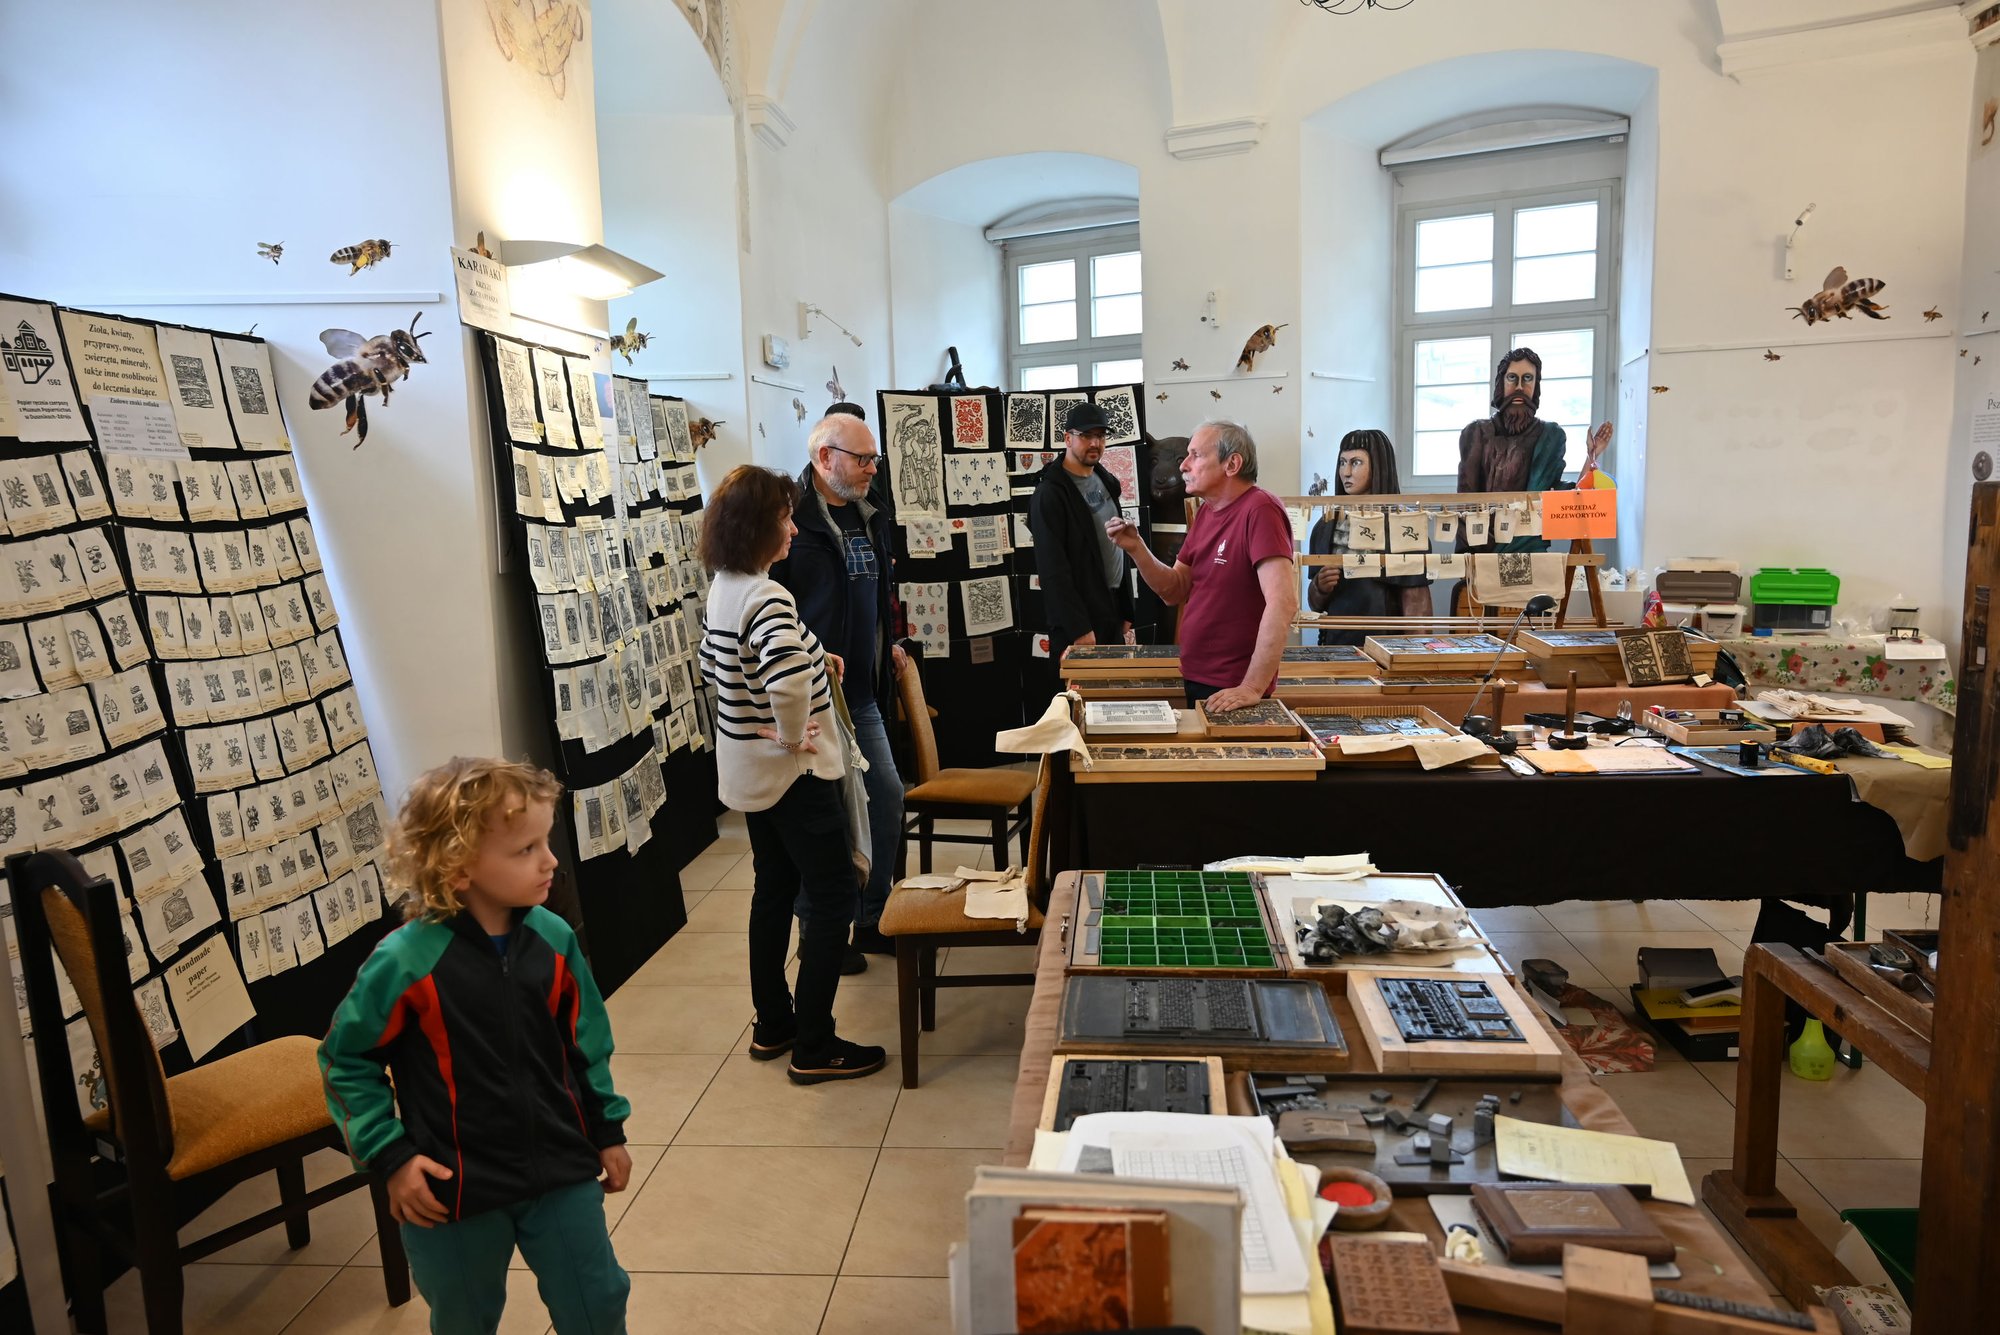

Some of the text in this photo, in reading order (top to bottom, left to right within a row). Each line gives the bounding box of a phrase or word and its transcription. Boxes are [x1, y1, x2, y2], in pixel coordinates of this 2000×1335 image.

[457, 256, 502, 281] KARAWAKI
[111, 327, 135, 340] kwiaty,
[83, 339, 145, 355] przyprawy, owoce,
[84, 352, 119, 365] zwierzęta,
[83, 366, 158, 383] także inne osobliwości
[92, 381, 101, 390] do
[102, 382, 131, 393] leczenia
[1560, 503, 1596, 511] SPRZEDAŻ
[1550, 511, 1608, 519] DRZEWORYTÓW
[175, 946, 211, 976] Handmade
[188, 965, 208, 986] paper
